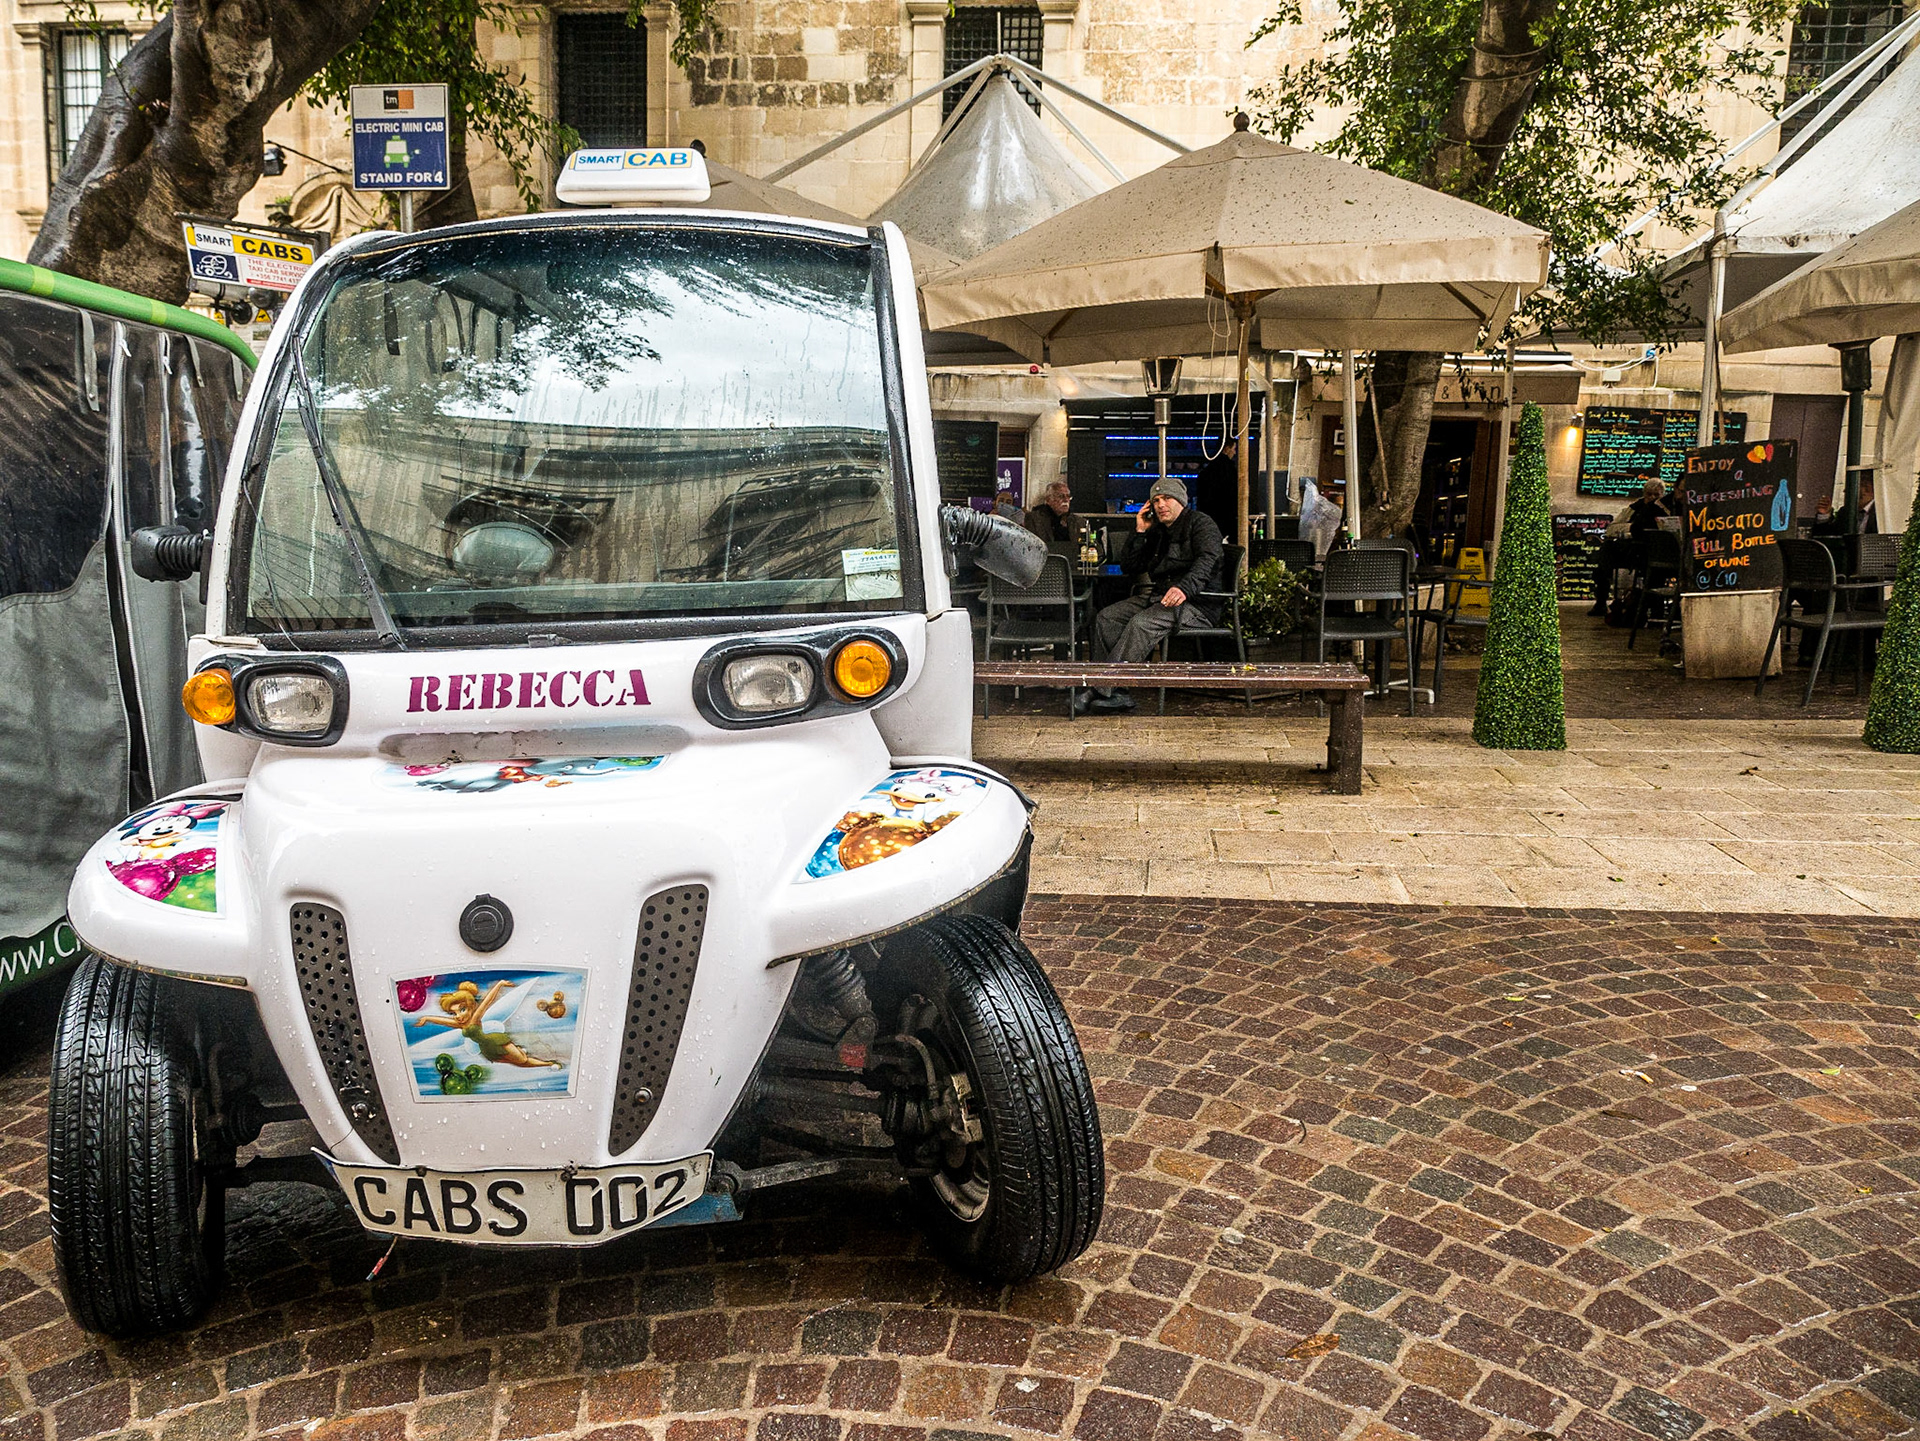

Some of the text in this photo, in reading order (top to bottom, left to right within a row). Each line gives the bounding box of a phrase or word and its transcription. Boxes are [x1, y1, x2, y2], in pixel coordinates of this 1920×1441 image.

[386, 96, 398, 104] tm
[355, 122, 444, 133] ELECTRIC MINI CAB
[578, 152, 688, 166] SMART CAB
[360, 171, 444, 184] STAND FOR 4
[196, 233, 303, 261] SMART CABS
[266, 262, 306, 272] ELECTRIC
[280, 270, 304, 278] SERVIC
[1441, 386, 1449, 400] &
[1687, 456, 1736, 474] ENJOY
[1734, 470, 1744, 481] a
[1692, 532, 1777, 554] FULL BOTTLE
[1719, 555, 1750, 568] WINE
[1696, 570, 1710, 590] @
[406, 669, 652, 713] REBECCA
[353, 1168, 688, 1237] CABS 002
